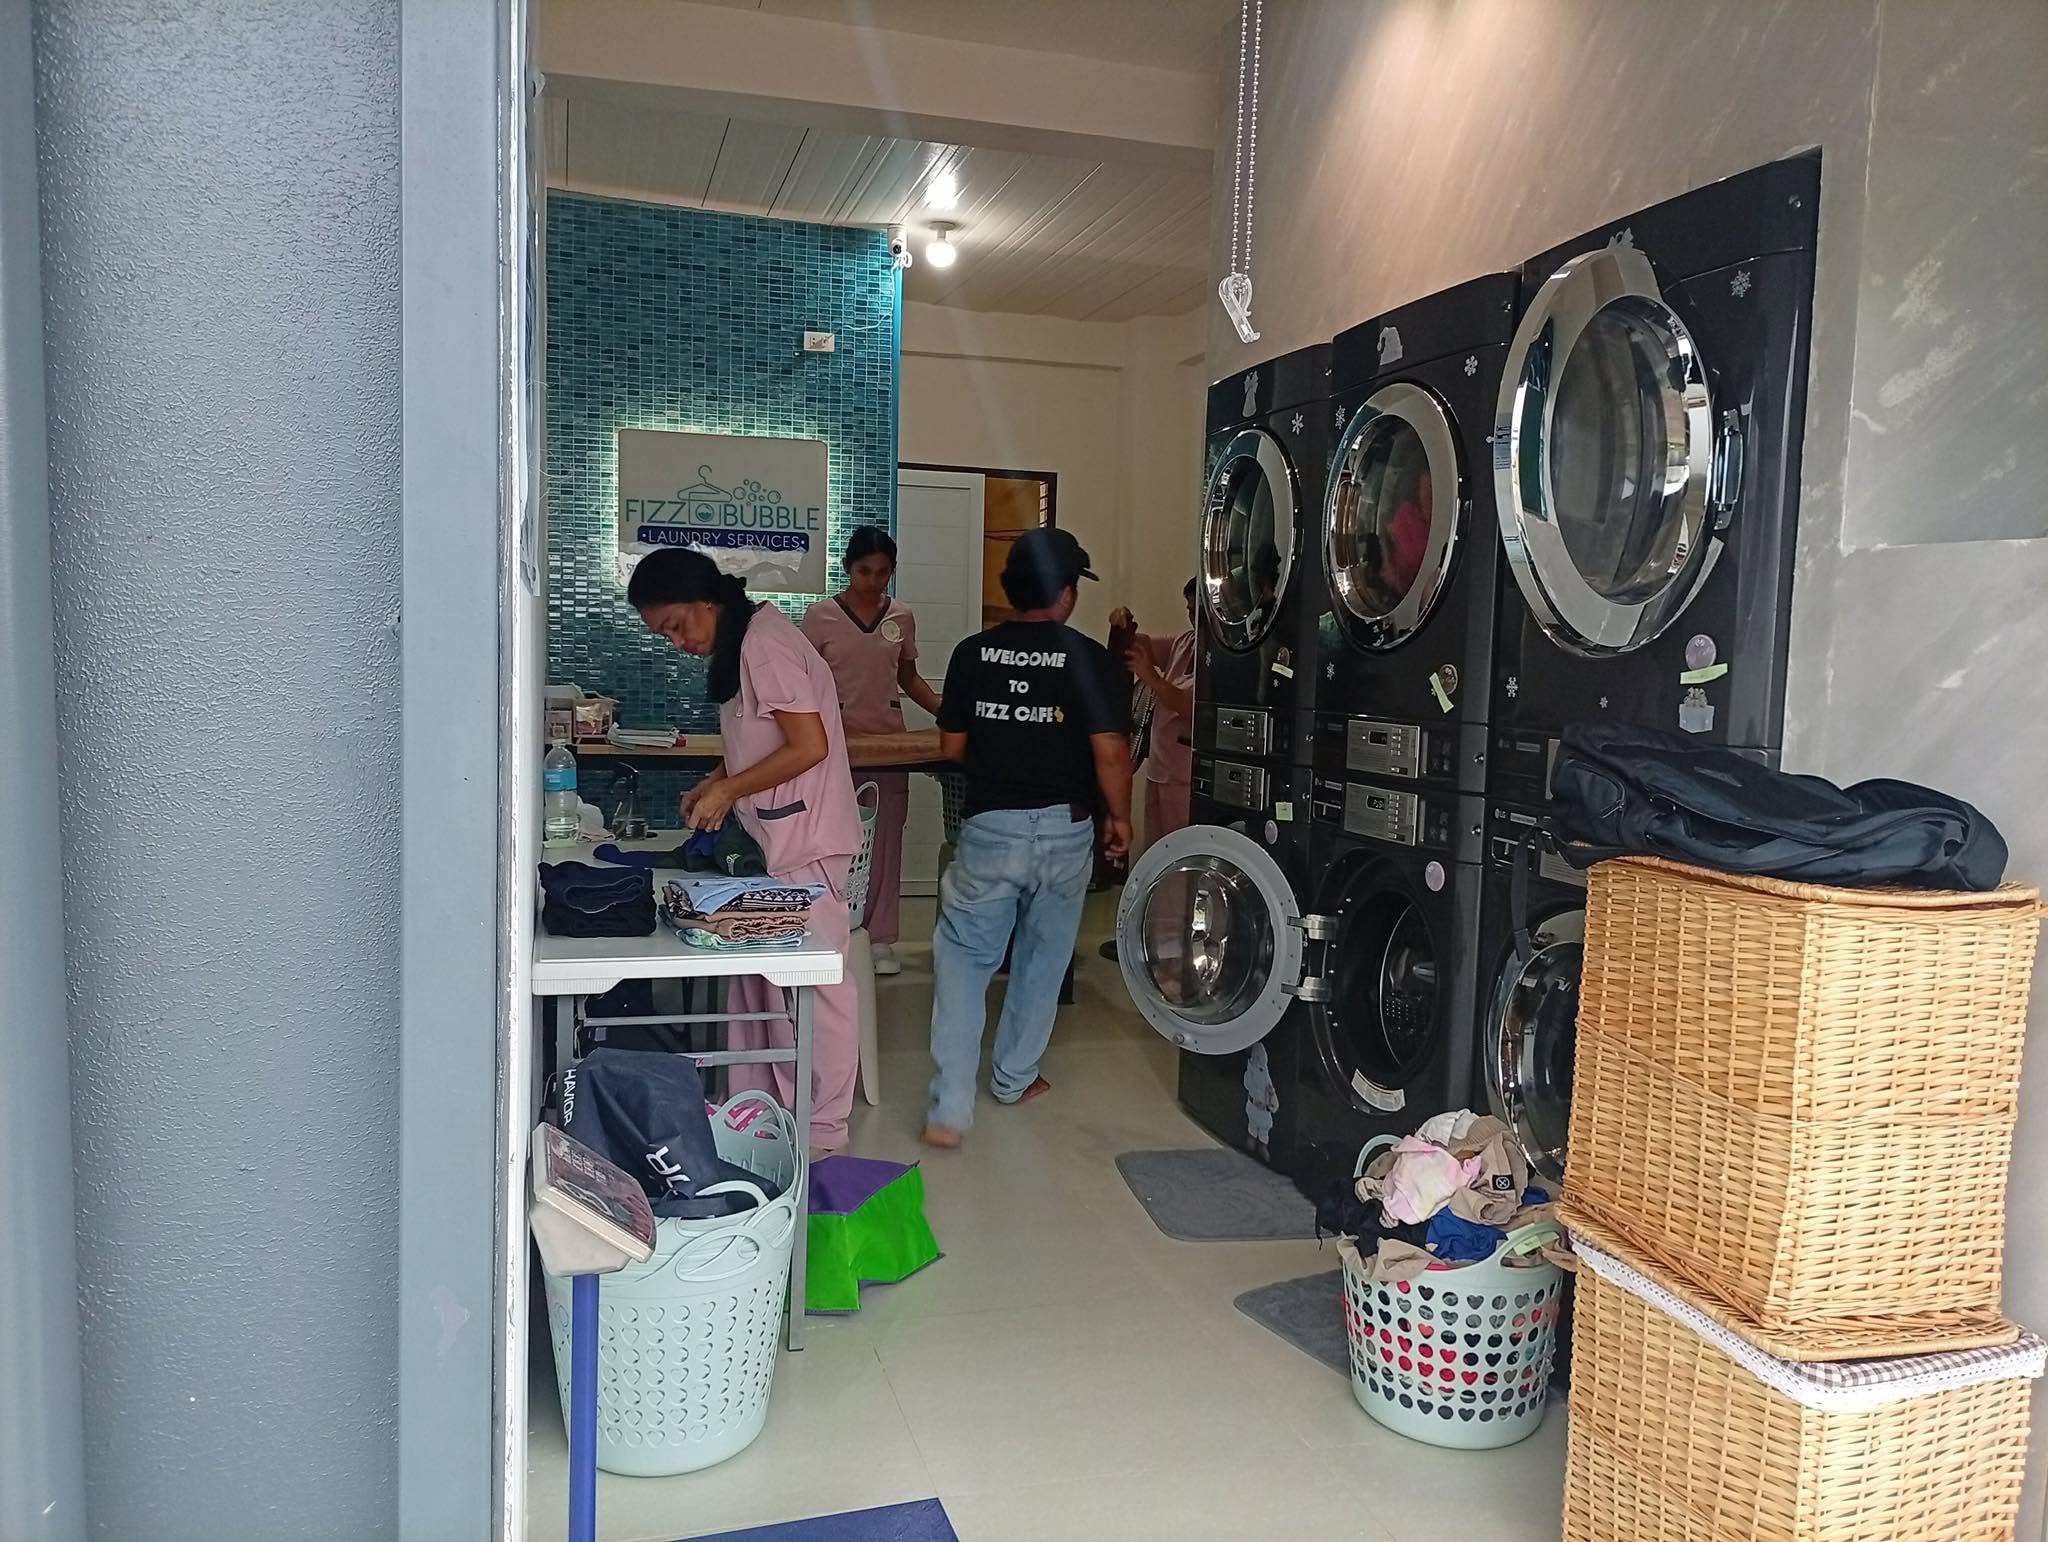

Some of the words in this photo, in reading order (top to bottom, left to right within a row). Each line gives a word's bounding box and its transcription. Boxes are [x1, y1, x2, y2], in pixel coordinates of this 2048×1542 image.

[625, 498, 687, 525] FIZZ
[723, 503, 820, 531] BUBBLE
[648, 530, 721, 546] LAUNDRY
[727, 533, 801, 548] SERVICES
[981, 647, 1066, 667] WELCOME
[1008, 679, 1030, 694] TO
[976, 701, 1009, 720] FIZZ
[1014, 705, 1054, 723] CAFE
[564, 1069, 577, 1126] HAVIOR
